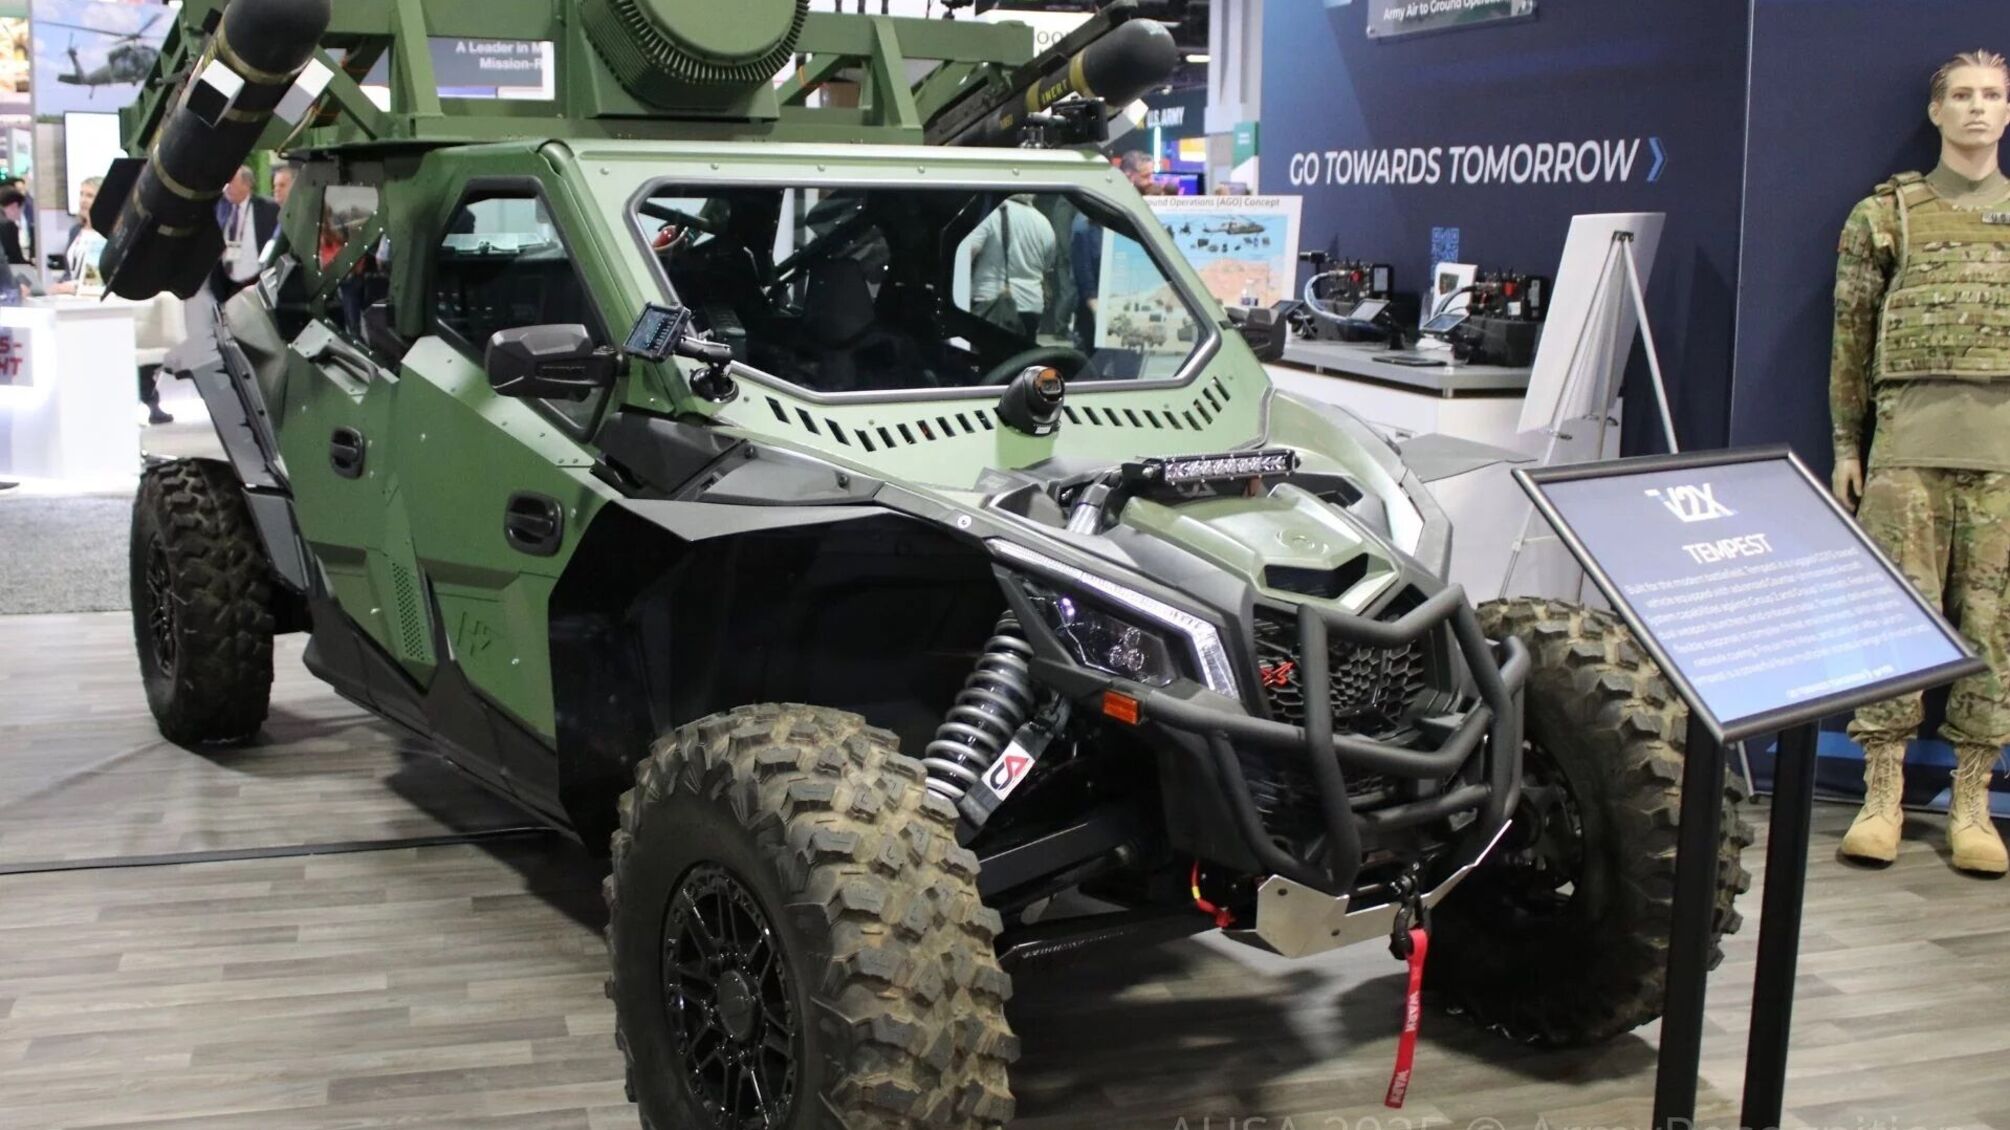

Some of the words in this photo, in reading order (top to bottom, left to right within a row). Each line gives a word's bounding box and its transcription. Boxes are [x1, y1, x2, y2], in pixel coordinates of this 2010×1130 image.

[1383, 8, 1405, 21] Army
[1406, 6, 1418, 17] Air
[1419, 3, 1429, 16] to
[1430, 0, 1463, 13] Ground
[456, 41, 466, 53] A
[468, 41, 515, 53] Leader
[516, 41, 528, 53] in
[1041, 79, 1068, 105] INERT
[1289, 152, 1320, 185] GO
[1324, 147, 1443, 185] TOWARDS
[1448, 138, 1641, 184] TOMORROW
[1169, 199, 1216, 208] Operations
[1216, 199, 1241, 208] (AGO)
[1244, 199, 1280, 208] Concept
[1645, 482, 1736, 523] V2X
[1682, 533, 1772, 564] TEMPEST
[1405, 990, 1420, 1033] WARN
[1389, 1069, 1410, 1103] WARN
